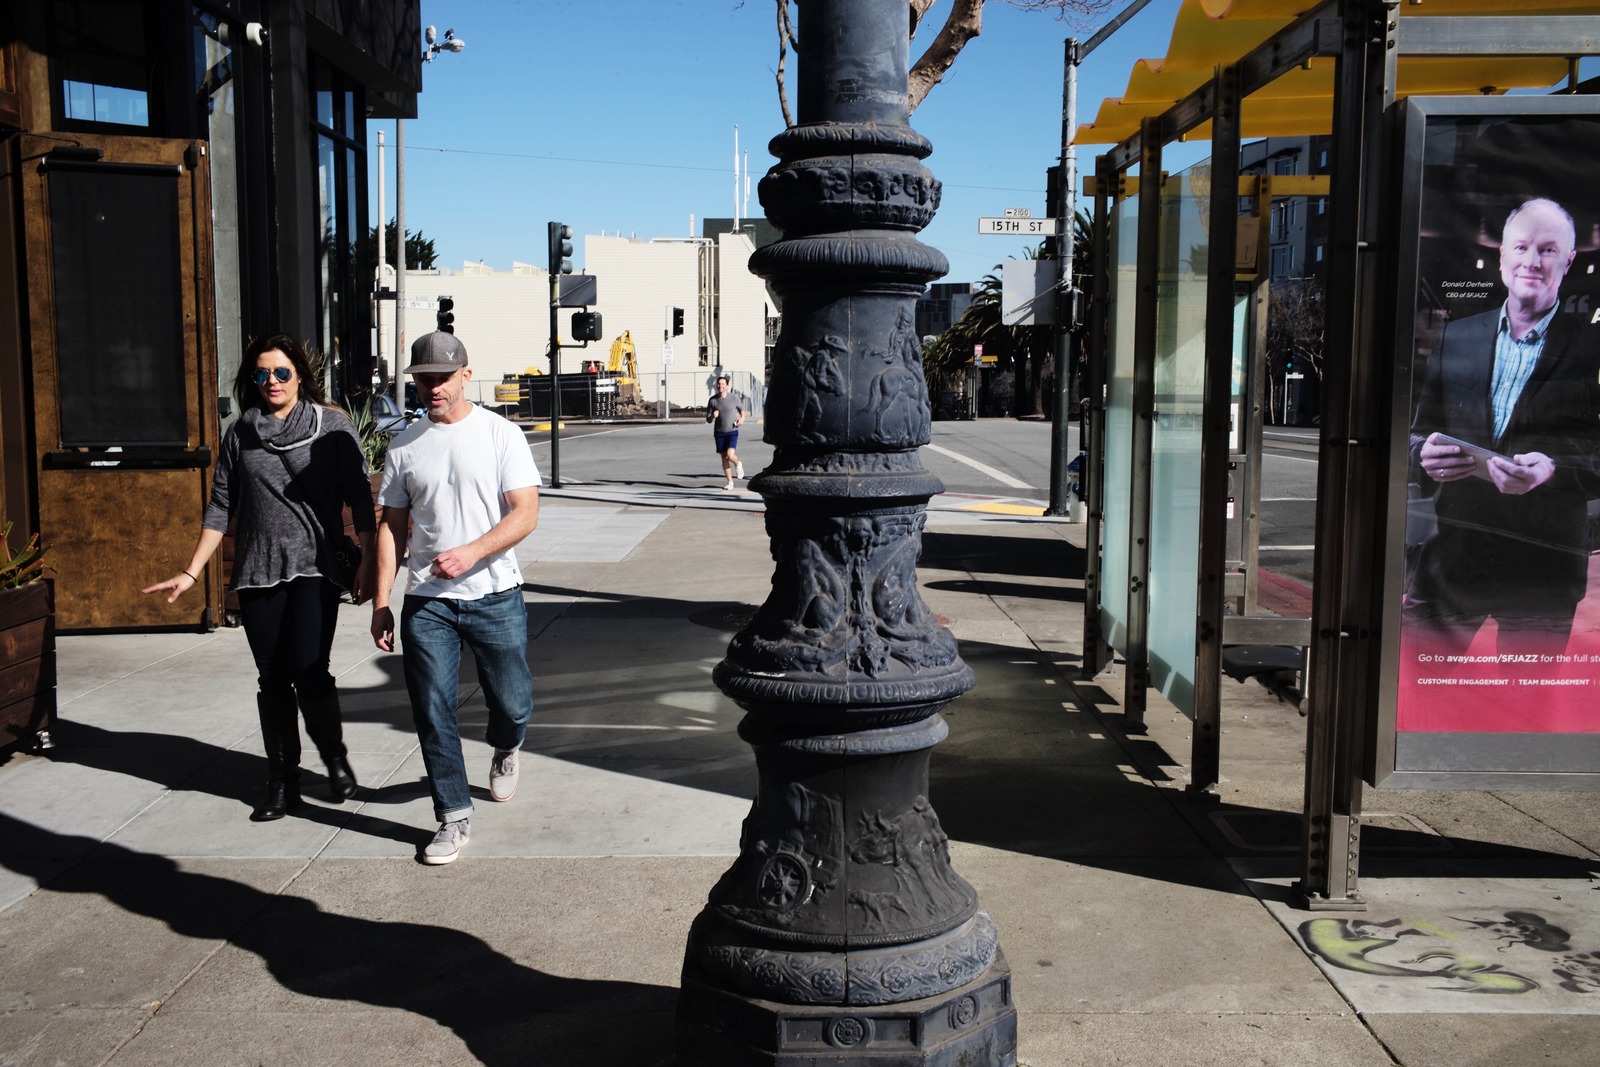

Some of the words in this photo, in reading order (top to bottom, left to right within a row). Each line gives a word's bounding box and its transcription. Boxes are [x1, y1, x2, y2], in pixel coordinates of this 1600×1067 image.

[992, 221, 1019, 232] 15TH
[1029, 221, 1043, 232] ST
[1441, 280, 1465, 288] Donald
[1466, 280, 1494, 288] Derheim
[1418, 653, 1432, 663] Go
[1434, 653, 1445, 663] to
[1447, 653, 1538, 664] avaya.com/SFJAZZ
[1541, 654, 1554, 663] for
[1556, 654, 1571, 663] the
[1573, 654, 1588, 663] full
